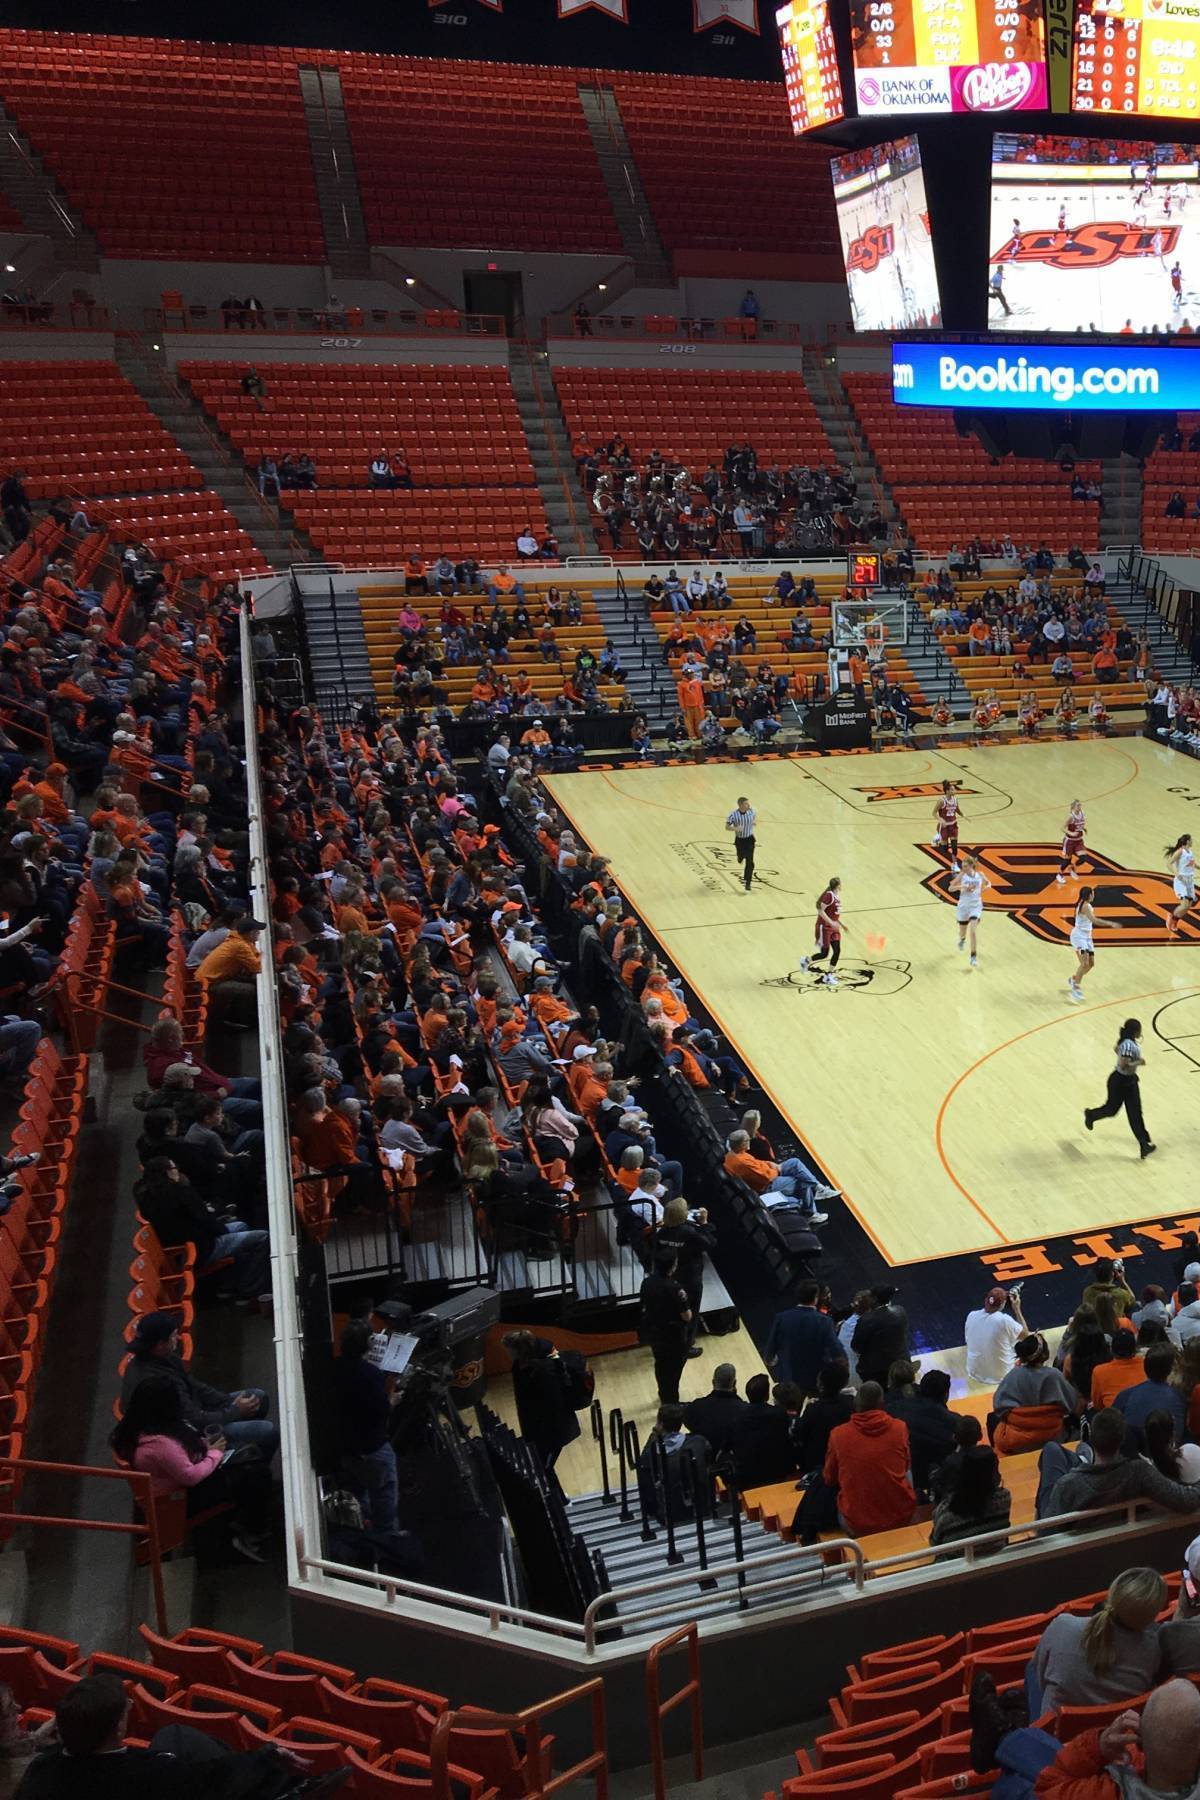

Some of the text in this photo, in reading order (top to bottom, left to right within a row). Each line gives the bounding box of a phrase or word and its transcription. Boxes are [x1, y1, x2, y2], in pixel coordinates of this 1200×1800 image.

[433, 14, 468, 26] 310
[870, 19, 895, 32] 0/0
[995, 13, 1019, 26] 0/0
[1000, 29, 1017, 42] 47
[1080, 26, 1096, 38] 12
[1104, 28, 1114, 40] 0
[711, 35, 735, 46] 311
[876, 34, 893, 48] 33
[881, 51, 891, 64] 1
[1003, 46, 1015, 60] 0
[1079, 44, 1136, 59] 14 0 0
[1103, 63, 1113, 75] 0
[1125, 64, 1136, 77] 0
[882, 78, 934, 92] BANK OF
[1077, 79, 1134, 95] 21 0 2
[883, 92, 951, 106] OKLAHOMA
[1076, 97, 1134, 112] 30 0 0
[990, 221, 1183, 269] OSU
[320, 337, 363, 349] 207
[659, 343, 697, 355] 208
[938, 356, 1160, 402] Booking.com
[856, 556, 877, 566] 9:42
[855, 565, 875, 583] 27
